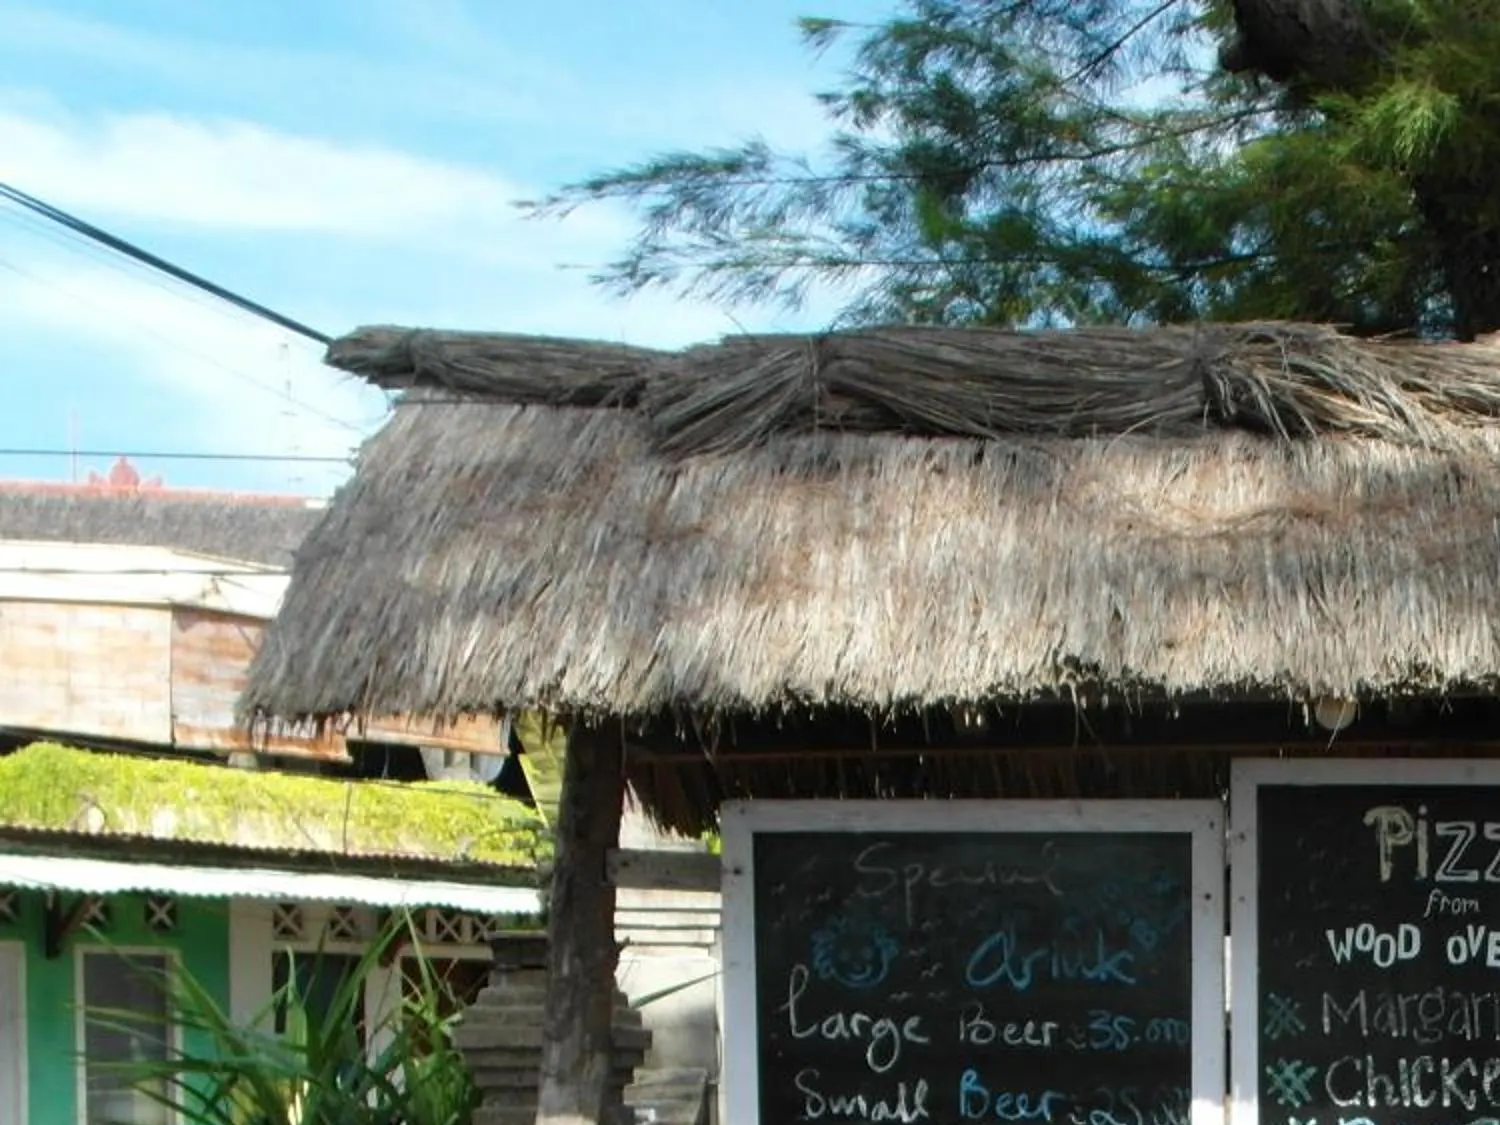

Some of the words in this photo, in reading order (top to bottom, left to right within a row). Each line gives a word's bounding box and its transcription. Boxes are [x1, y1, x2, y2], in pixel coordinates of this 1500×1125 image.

[1424, 889, 1480, 917] from
[780, 964, 929, 1071] Large
[960, 1003, 1058, 1046] Beer
[794, 1068, 929, 1125] Small
[960, 1068, 1065, 1124] Beer
